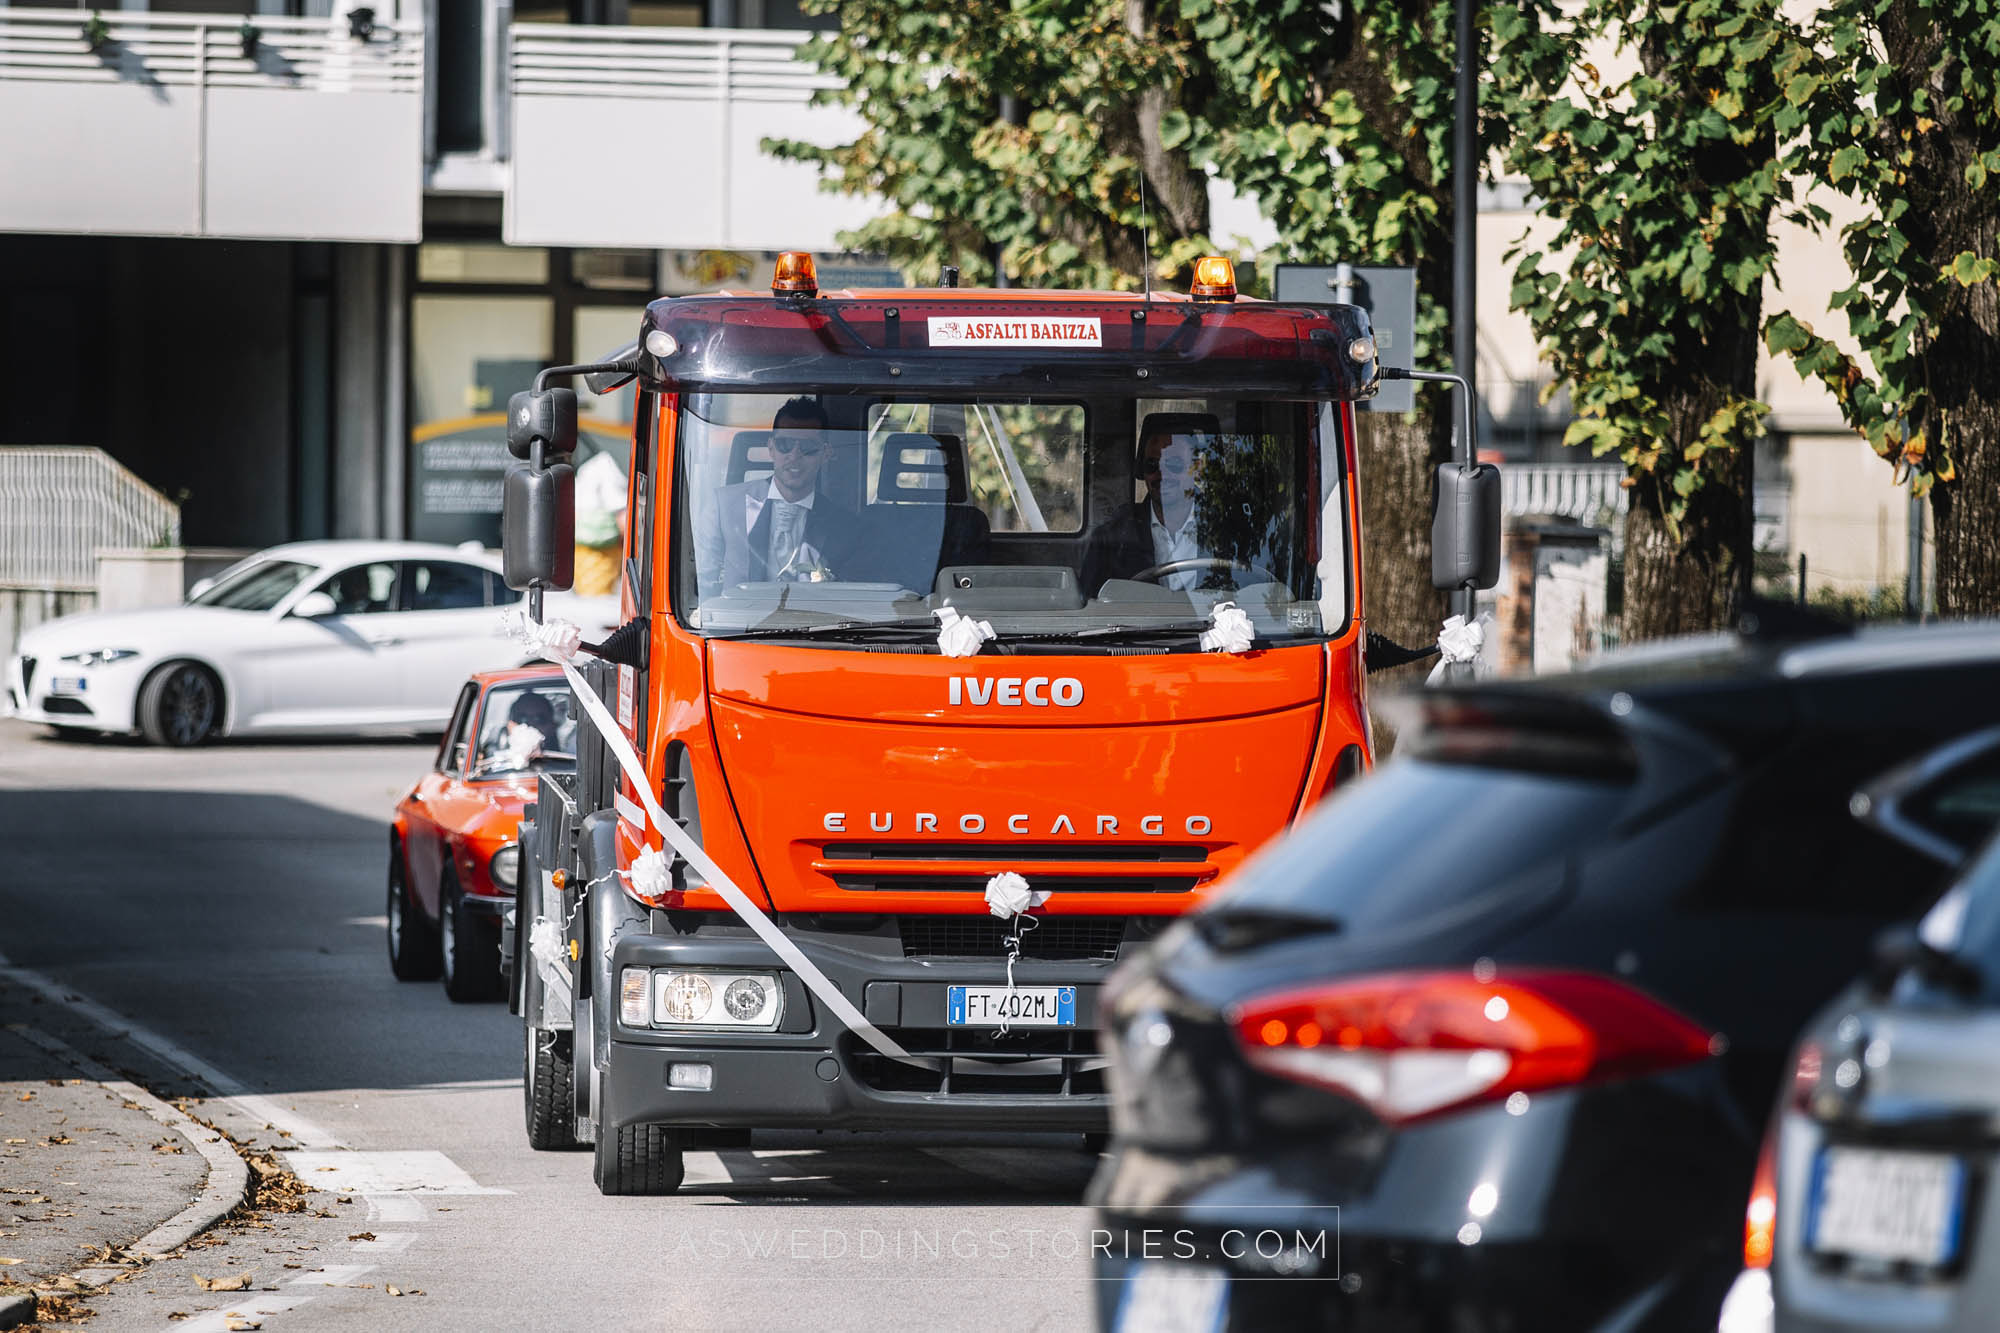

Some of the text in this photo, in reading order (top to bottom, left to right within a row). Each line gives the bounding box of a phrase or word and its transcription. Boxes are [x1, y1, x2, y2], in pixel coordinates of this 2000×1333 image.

[964, 323, 1099, 340] ASFALTI BARIZZA
[947, 675, 1085, 708] IVECO
[822, 811, 1213, 837] EUROCARGO
